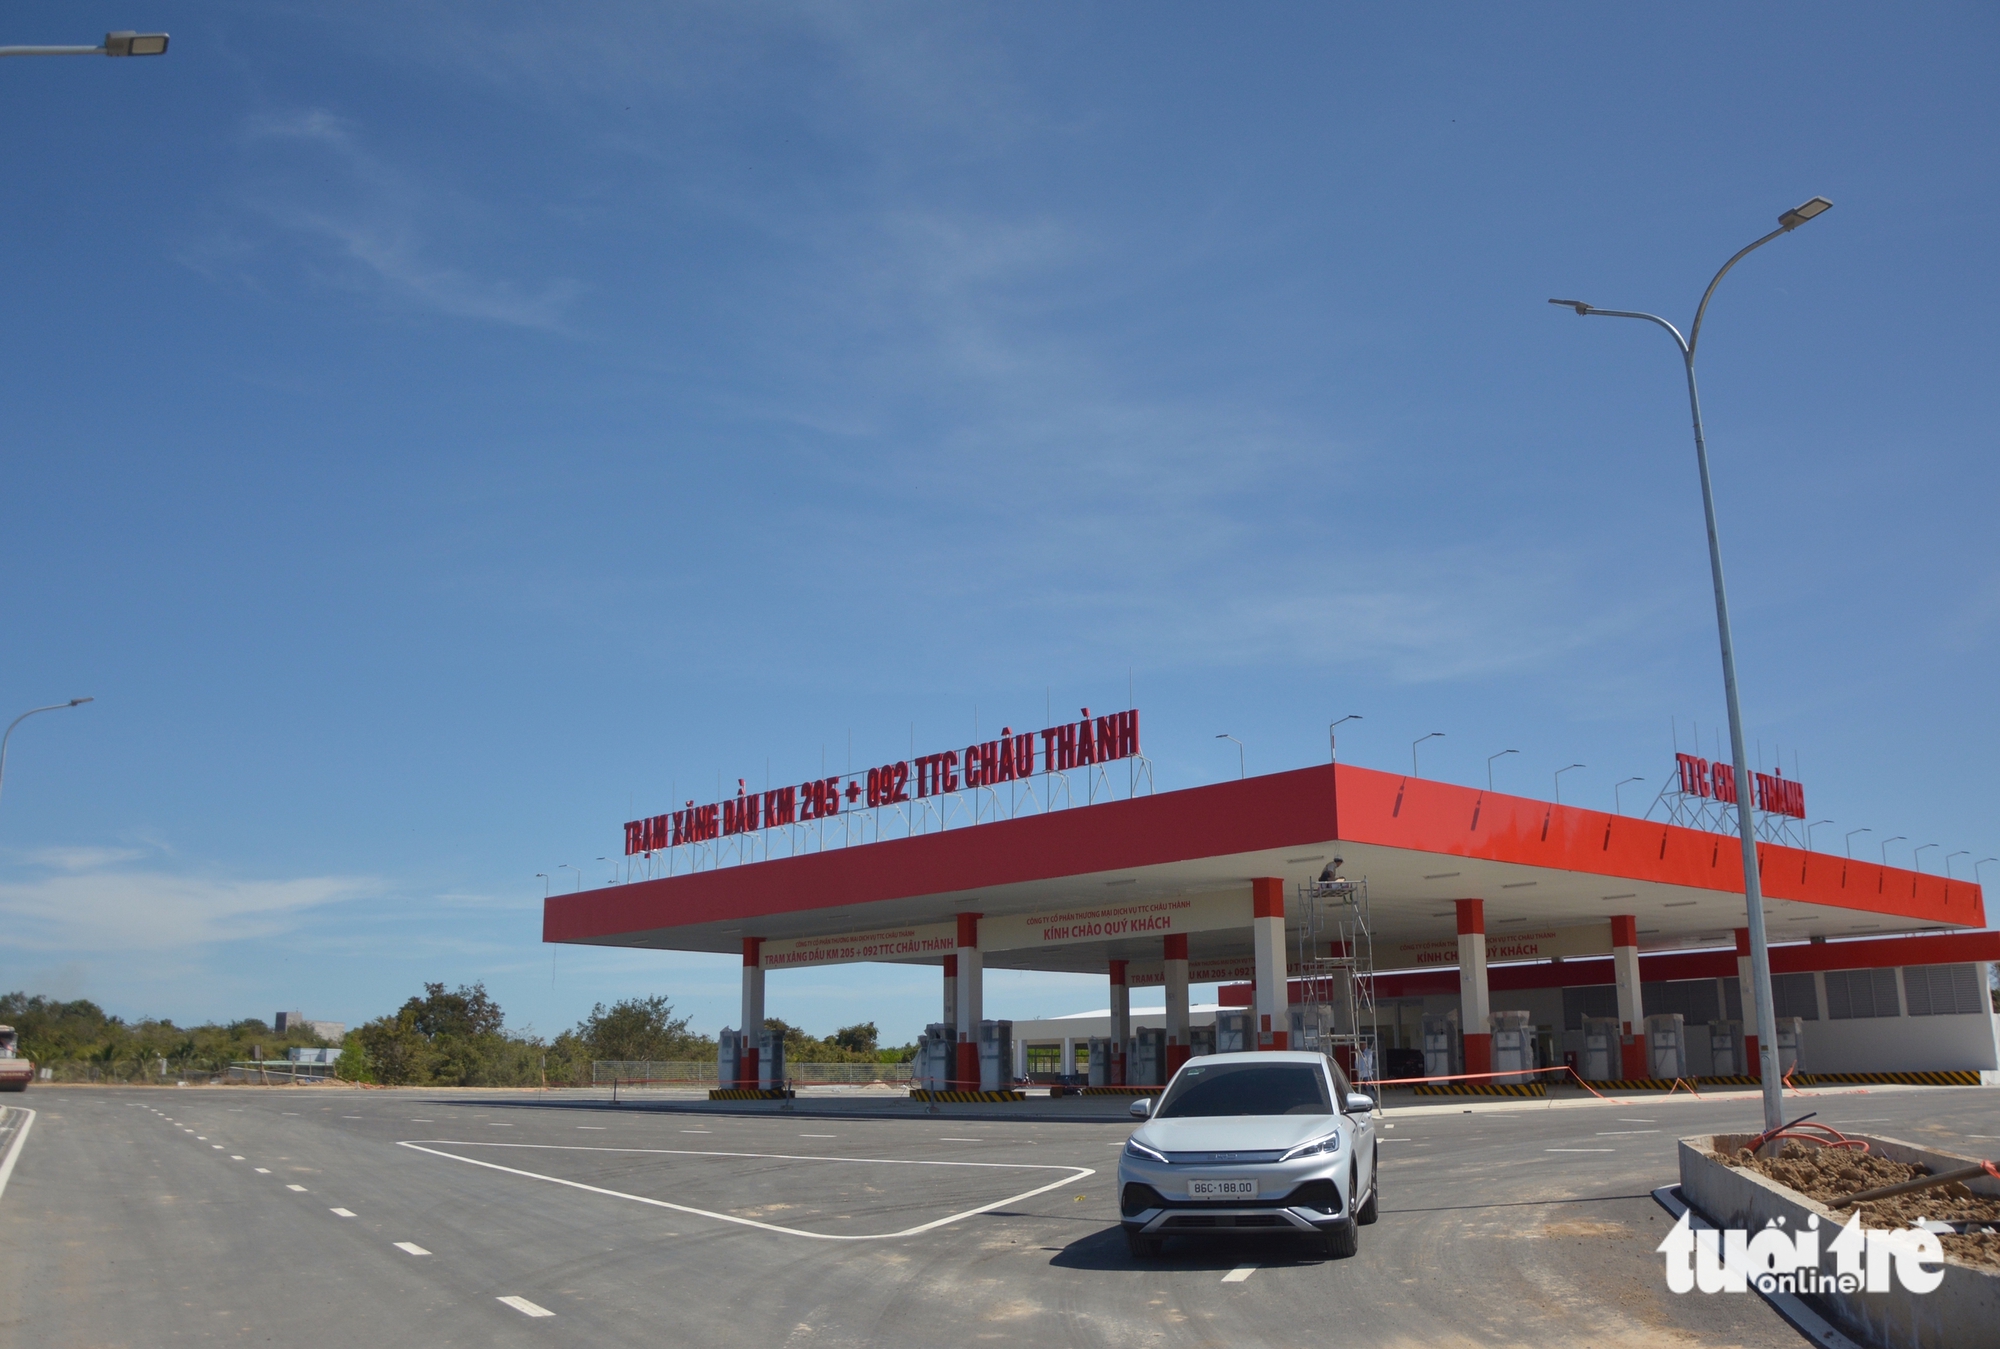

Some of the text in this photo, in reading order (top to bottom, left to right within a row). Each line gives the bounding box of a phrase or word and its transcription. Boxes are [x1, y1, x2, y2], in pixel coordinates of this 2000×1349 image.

[624, 708, 1140, 858] TRẠM XĂNG DẦU KM 205 + 092 TTC CHÂU THÀNH
[1676, 753, 1806, 819] TTC CH THÀNH
[1026, 915, 1042, 925] CÔNG
[1075, 910, 1100, 919] THƯƠNG
[1101, 909, 1112, 918] MẠI
[1113, 907, 1127, 917] DỊCH
[1128, 906, 1137, 915] VỤ
[1138, 905, 1149, 913] TTC
[1150, 902, 1167, 912] CHÂU
[1168, 900, 1191, 909] THÀNH
[1043, 915, 1171, 940] KÍNH CHÀO QUÝ KHÁCH
[765, 953, 785, 967] TRẠM
[787, 951, 807, 963] XĂNG
[826, 949, 838, 959] KM
[840, 948, 855, 958] 205
[863, 946, 878, 956] 092
[879, 944, 895, 954] TTC
[896, 940, 920, 953] CHÂU
[922, 937, 954, 951] THÀNH
[1417, 943, 1538, 963] KÍNH CH UÝ KHÁCH
[1131, 973, 1153, 985] TRẠM
[1196, 969, 1209, 979] KM
[1211, 968, 1226, 978] 205
[1234, 967, 1250, 976] 092
[1194, 1182, 1252, 1193] 86C-188.00
